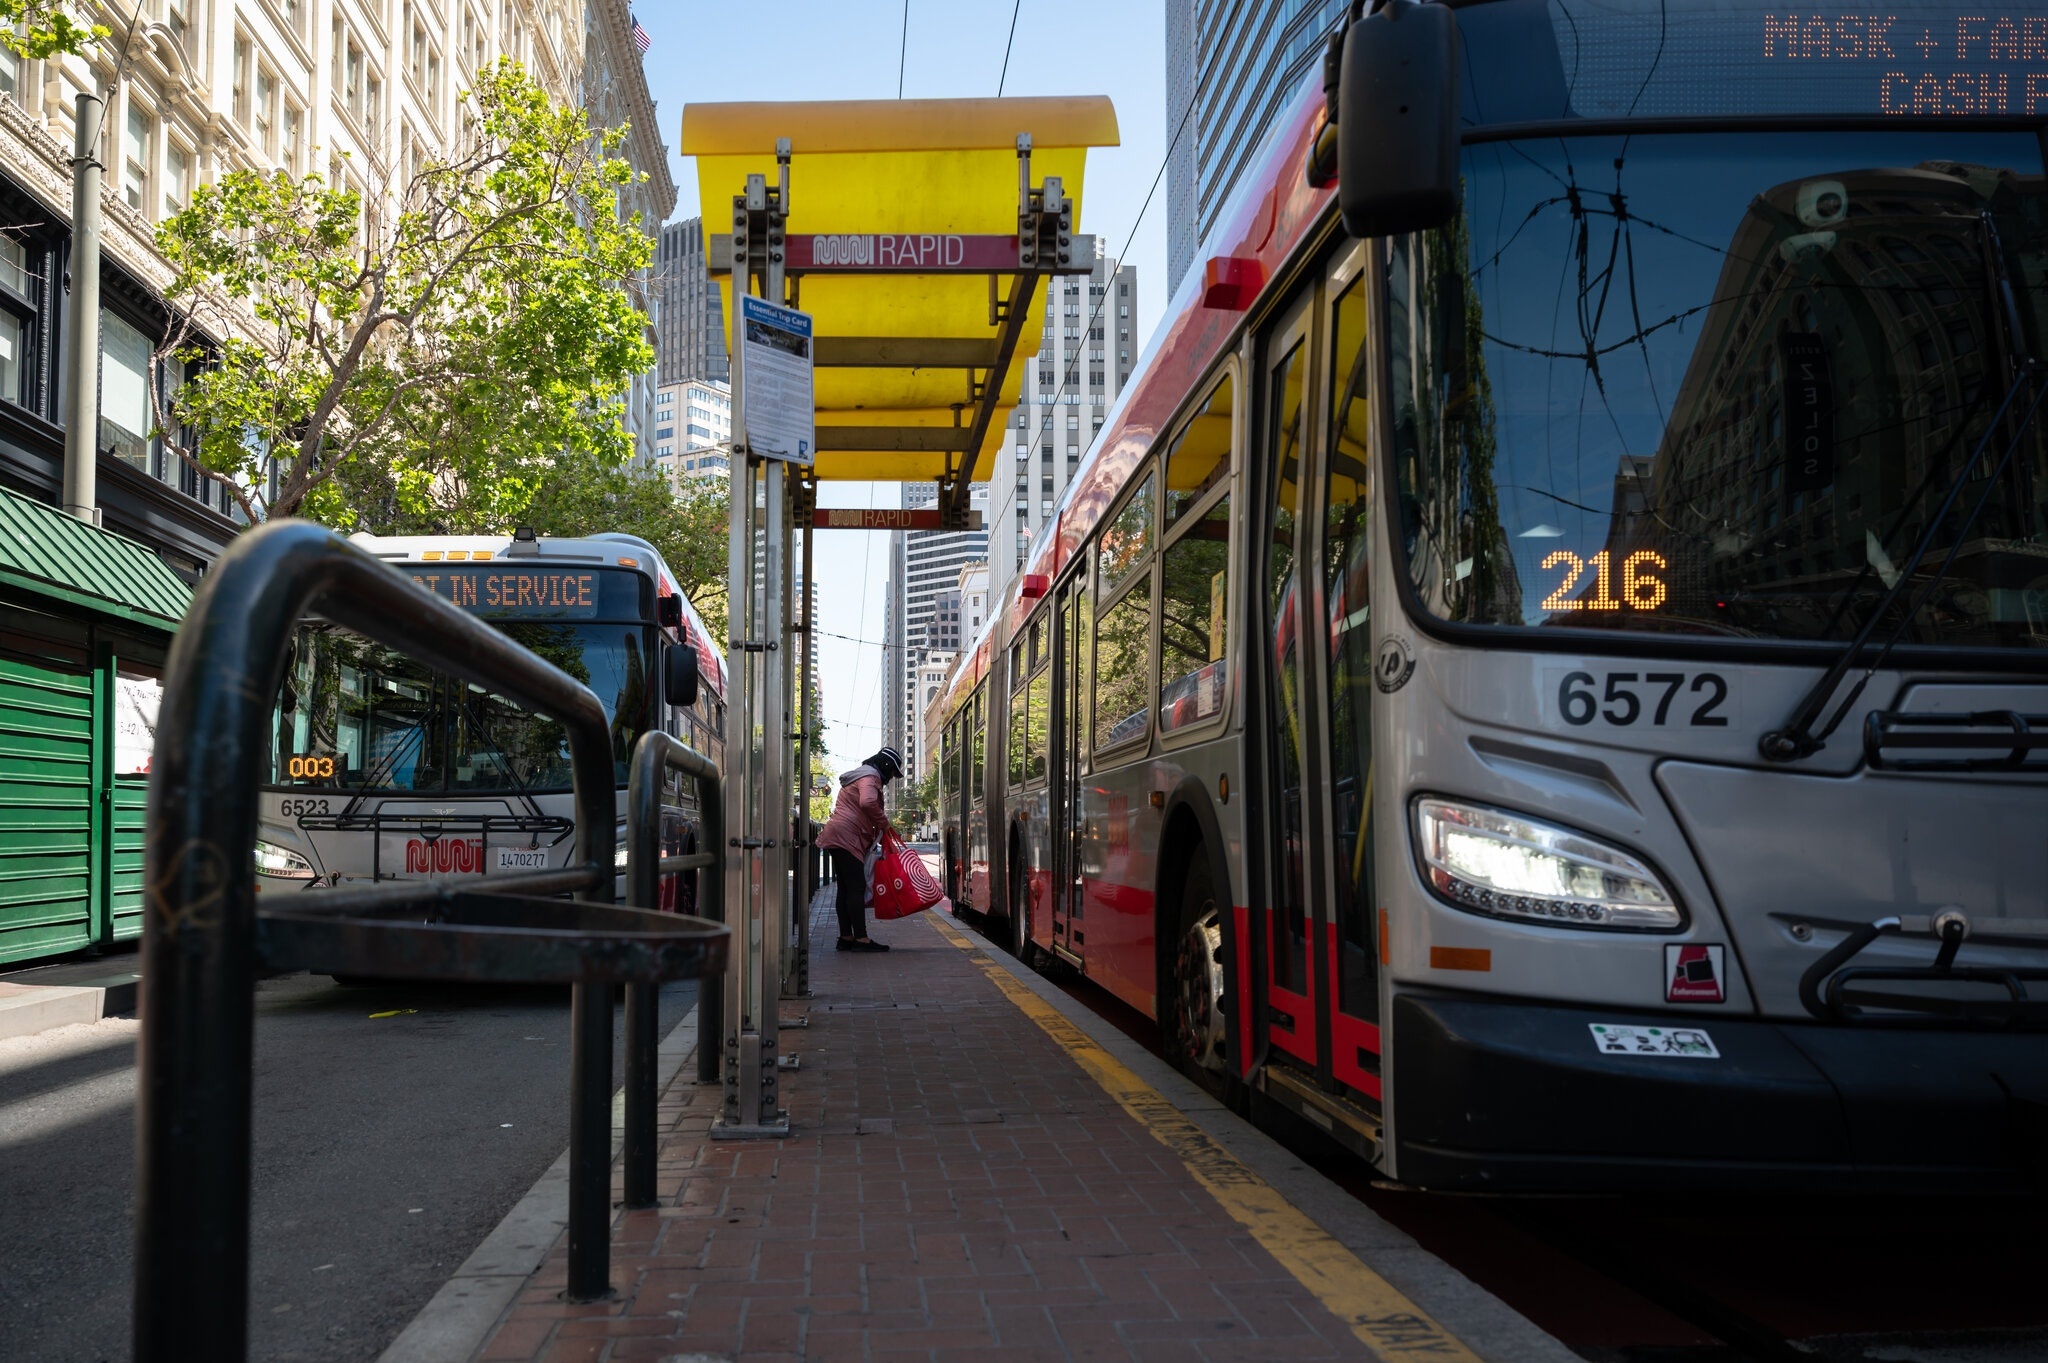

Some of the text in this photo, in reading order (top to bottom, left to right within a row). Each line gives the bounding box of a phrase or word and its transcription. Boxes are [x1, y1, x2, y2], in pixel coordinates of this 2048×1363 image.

[1764, 15, 1897, 58] MASK
[1881, 72, 2008, 115] CASH
[879, 235, 964, 265] RAPID
[748, 302, 777, 318] Essential
[777, 311, 791, 323] Trip
[791, 315, 808, 327] Card
[864, 510, 912, 527] RAPID
[449, 575, 478, 606] IN
[487, 575, 593, 607] SERVICE
[1541, 550, 1666, 611] 216
[1557, 670, 1729, 727] 6572
[289, 757, 333, 778] 003
[281, 799, 329, 817] 6523
[501, 853, 545, 867] 1470277
[1672, 987, 1718, 997] Enforcement
[1355, 1312, 1459, 1355] STAY
